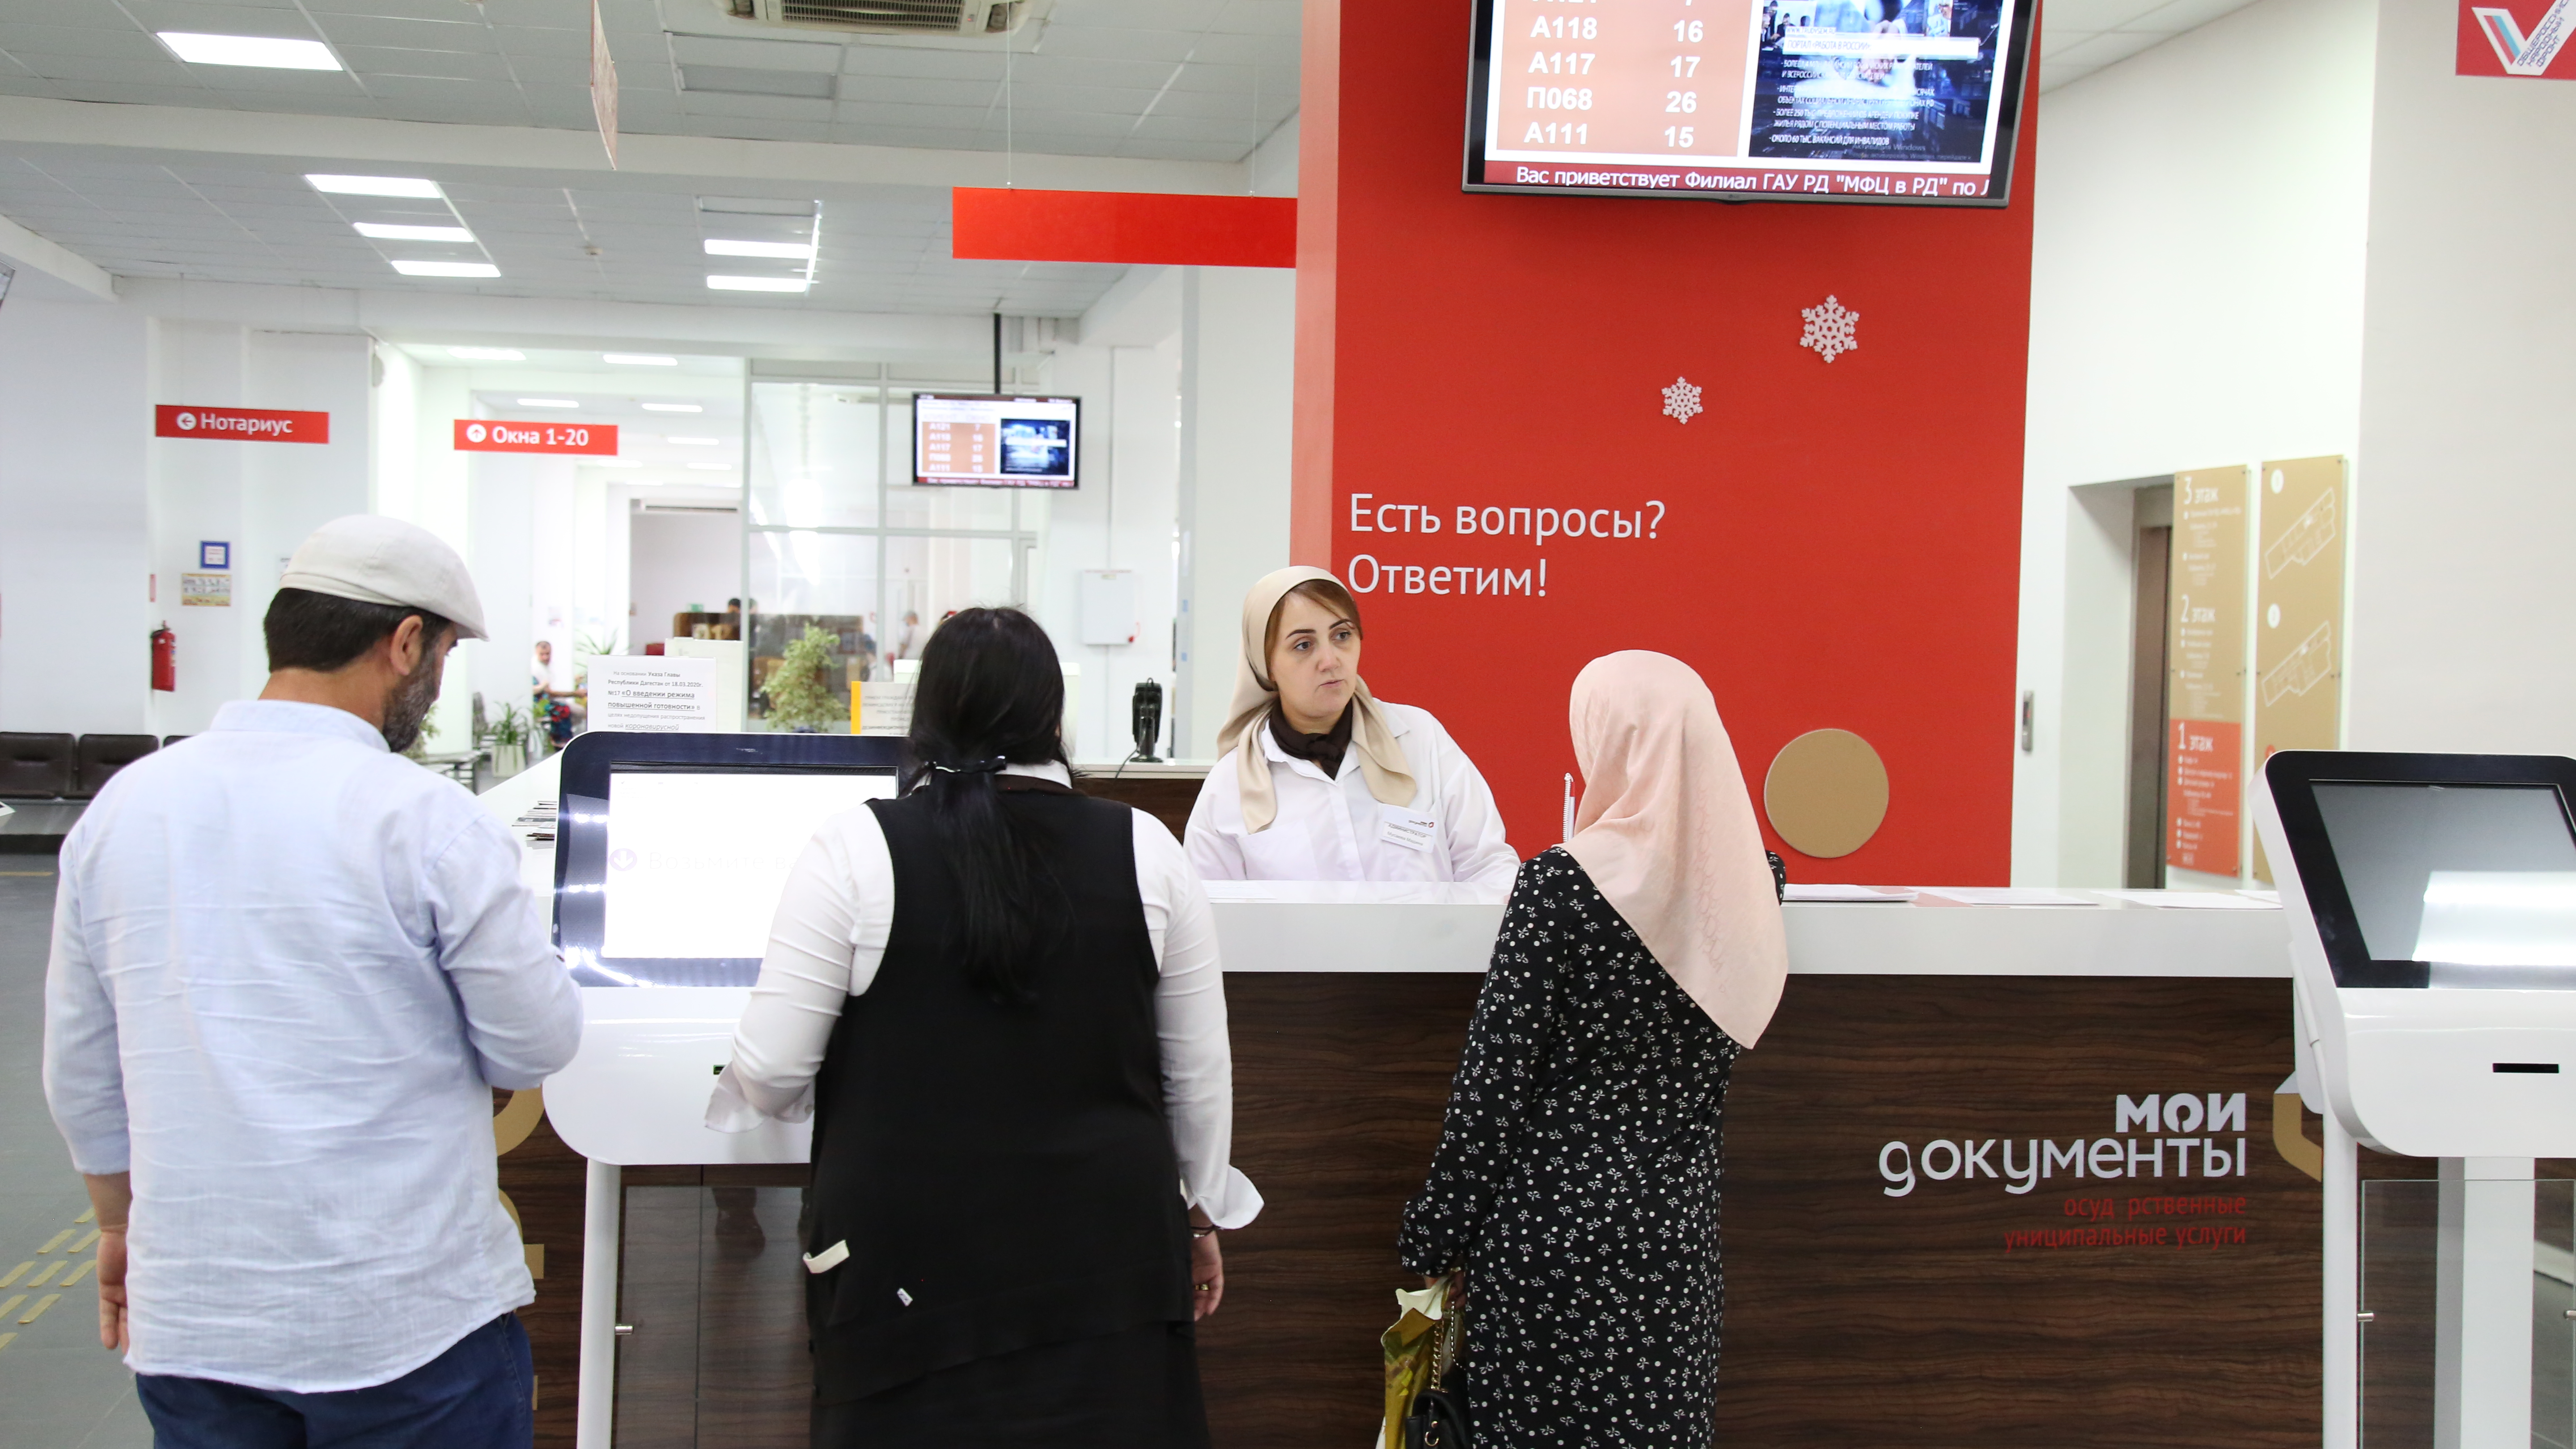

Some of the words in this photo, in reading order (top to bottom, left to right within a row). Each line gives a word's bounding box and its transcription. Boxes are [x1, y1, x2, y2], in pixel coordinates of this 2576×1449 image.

[1530, 15, 1597, 39] А118
[1674, 20, 1703, 42] 16
[1788, 40, 1811, 49] ПОРТАЛ
[1528, 51, 1596, 75] А117
[1670, 56, 1700, 78] 17
[1526, 86, 1593, 110] П068
[1665, 91, 1697, 114] 26
[1523, 122, 1588, 144] А111
[1664, 126, 1694, 148] 15
[1516, 166, 1549, 184] Вас
[1555, 170, 1680, 189] приветствует
[1685, 171, 1757, 190] Филиал
[1763, 173, 1799, 190] ГАУ
[1804, 174, 1829, 193] РД
[1895, 183, 1907, 193] в
[1953, 181, 1976, 195] по
[200, 414, 292, 436] Нотариус
[491, 426, 540, 445] Окна
[545, 428, 589, 446] 1-20
[2183, 476, 2192, 505] 3
[2194, 487, 2219, 504] этаж
[1351, 493, 1441, 534] Есть
[1456, 500, 1666, 546] вопросы?
[1348, 554, 1546, 597] Ответим!
[2180, 594, 2189, 623] 2
[2191, 607, 2216, 623] этаж
[2178, 721, 2186, 750] 1
[2189, 735, 2214, 752] этаж
[650, 852, 764, 870] Возьмите
[2175, 1225, 2246, 1250] услуги
